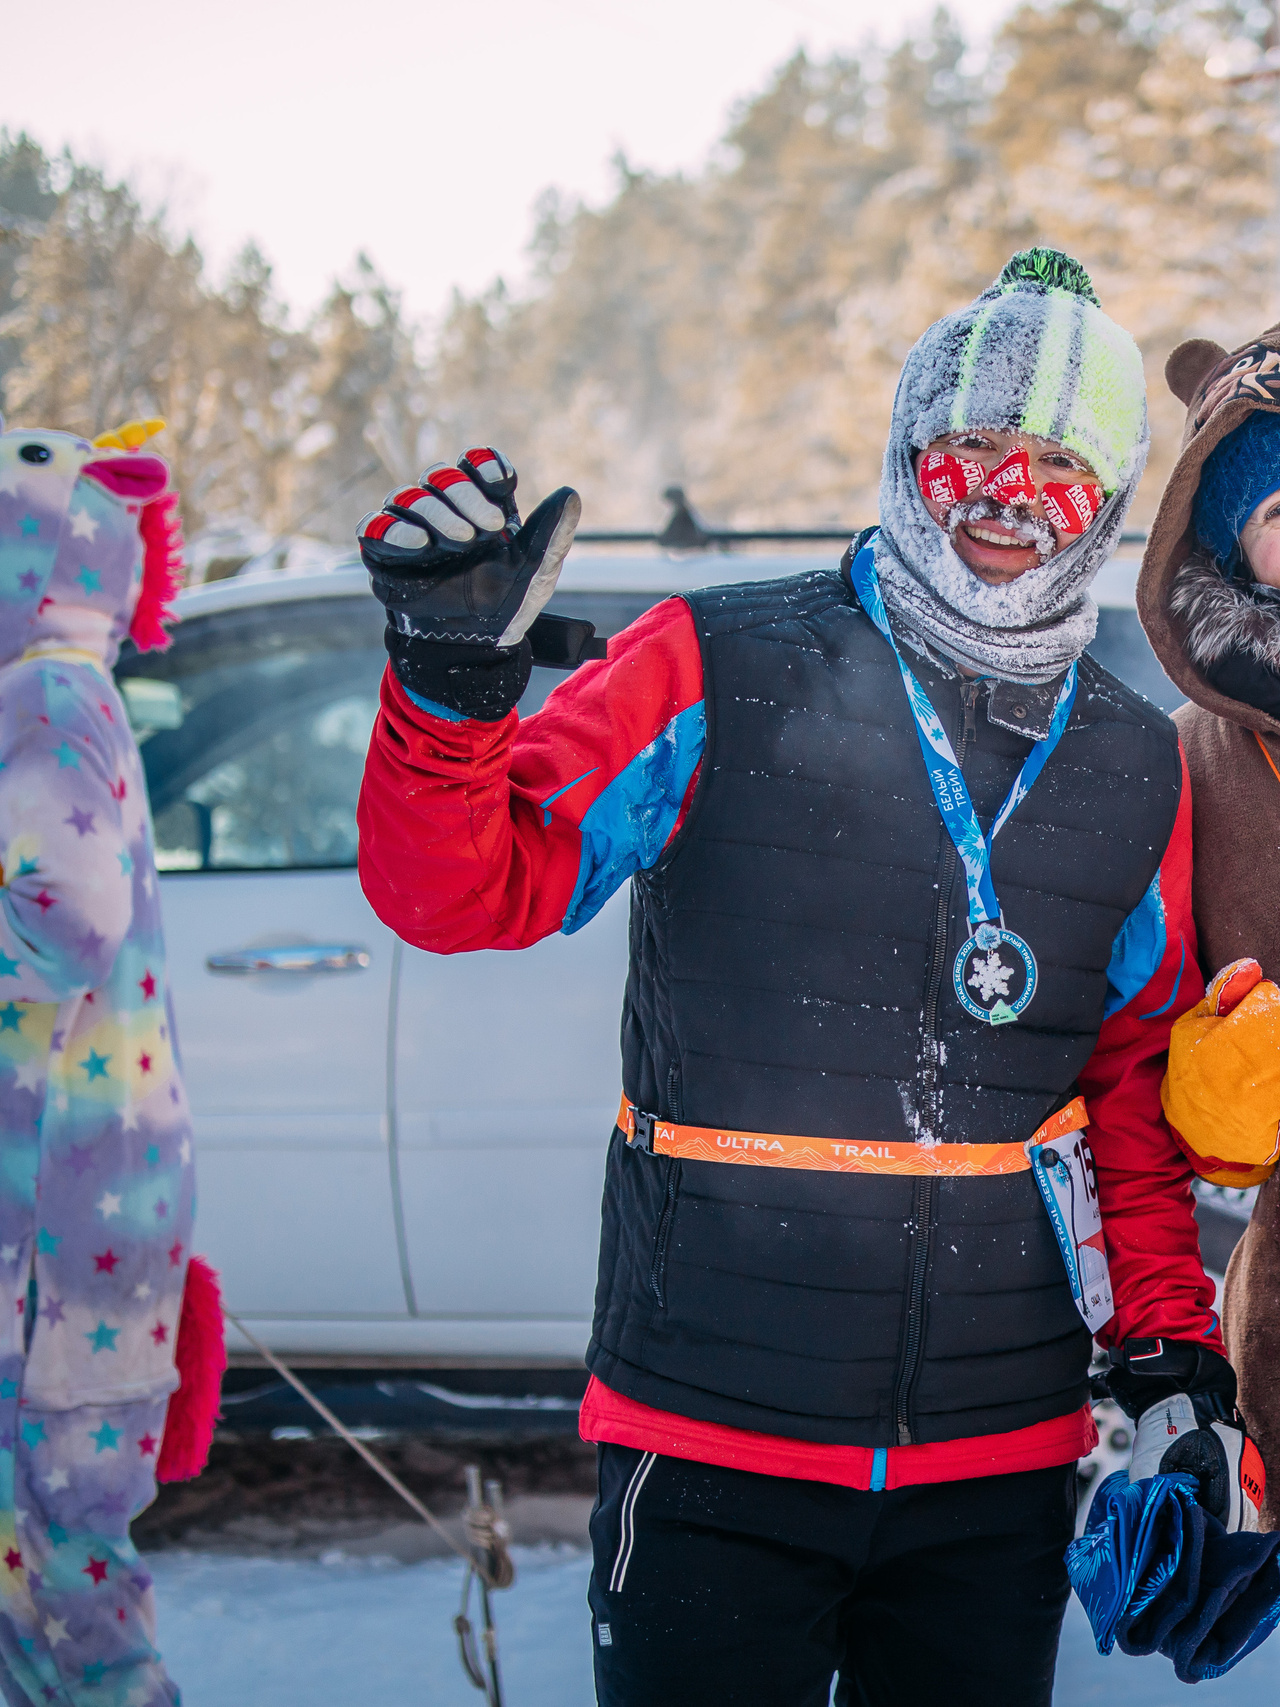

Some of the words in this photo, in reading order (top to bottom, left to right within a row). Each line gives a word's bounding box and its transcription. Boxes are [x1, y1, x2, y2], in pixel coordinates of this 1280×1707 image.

[930, 768, 954, 811] БЕЛЫЙ
[948, 768, 966, 808] ТРЕЙЛ
[961, 941, 974, 957] 2023
[956, 958, 964, 982] SERIES
[956, 985, 969, 1004] TRAIL
[968, 1004, 988, 1017] TAIGA
[1058, 1108, 1074, 1125] ULTRA
[654, 1126, 675, 1141] TAI
[716, 1135, 785, 1153] ULTRA
[830, 1143, 897, 1160] TRAIL
[1034, 1158, 1052, 1203] SERIES
[1050, 1205, 1067, 1244] TRAIL
[1064, 1245, 1077, 1290] TAIGA
